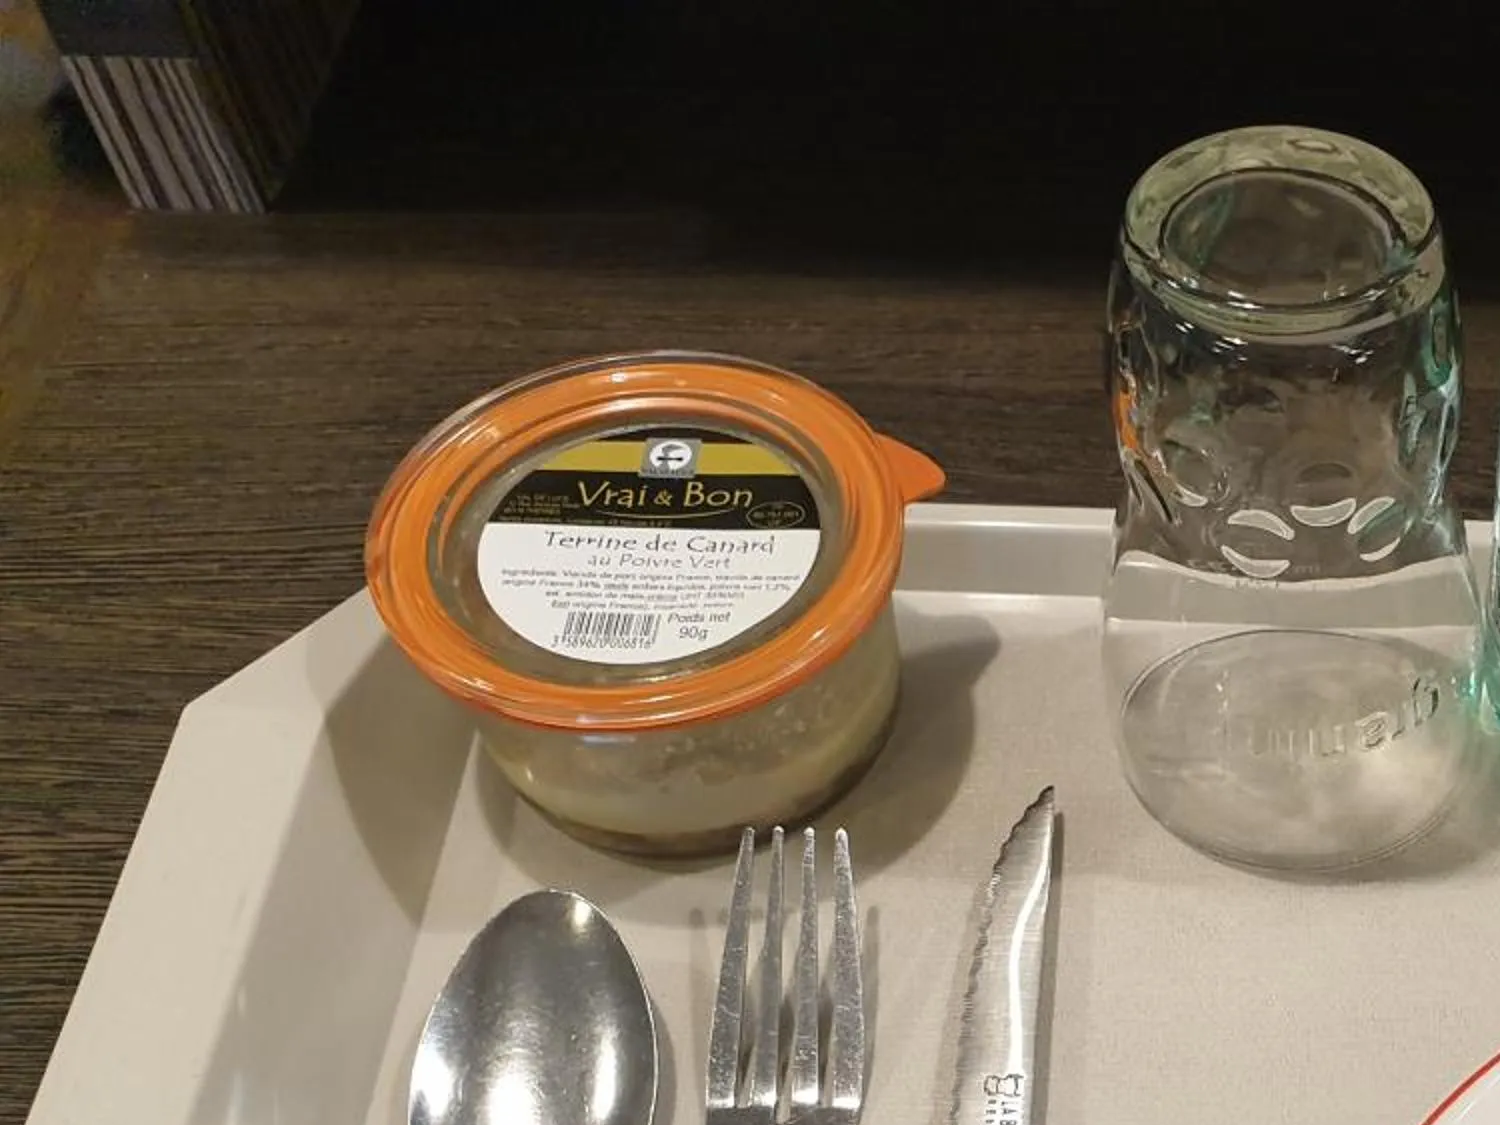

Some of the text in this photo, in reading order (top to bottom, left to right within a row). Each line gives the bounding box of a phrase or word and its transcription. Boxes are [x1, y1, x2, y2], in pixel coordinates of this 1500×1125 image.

[578, 481, 648, 508] Vrai
[654, 490, 674, 507] &
[683, 481, 753, 508] Bon
[545, 529, 776, 556] Terrine de Canard
[619, 553, 684, 569] Poivre
[689, 555, 731, 570] Vert
[678, 625, 709, 641] 90g
